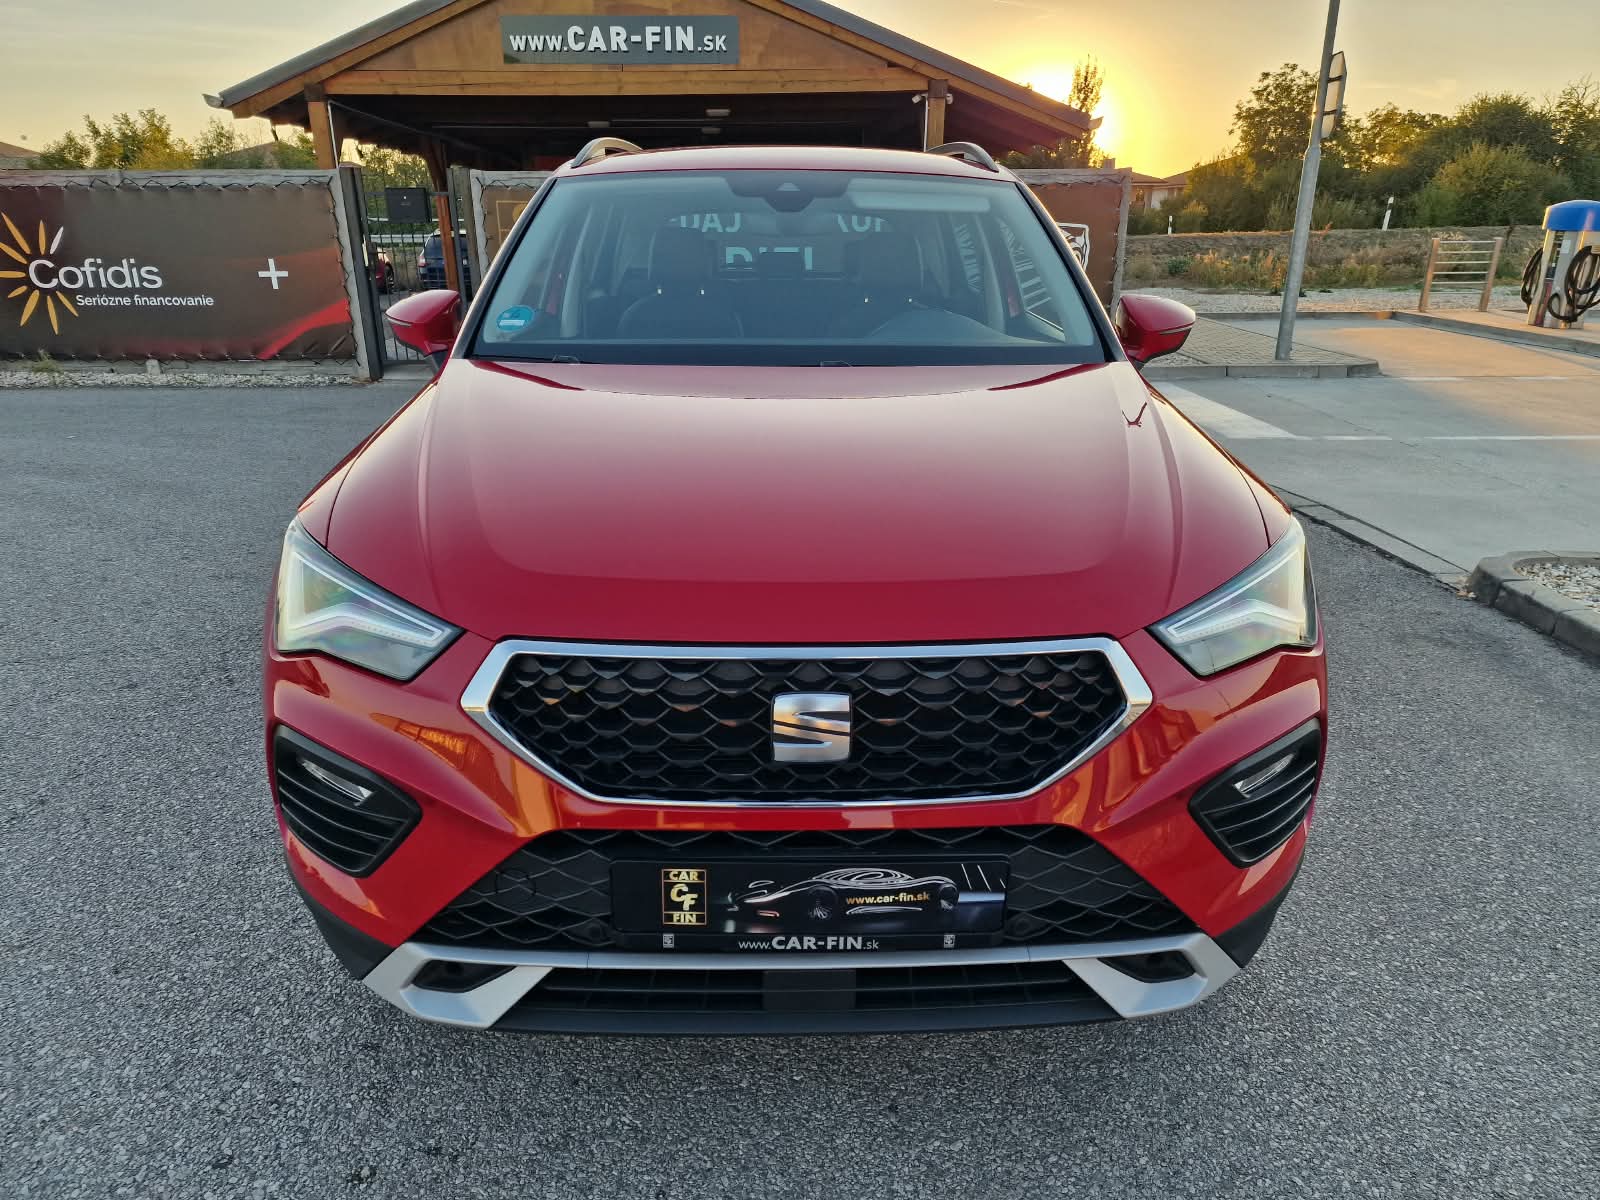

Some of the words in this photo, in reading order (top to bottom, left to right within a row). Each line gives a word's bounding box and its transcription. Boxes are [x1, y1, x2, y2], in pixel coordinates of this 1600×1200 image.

[28, 258, 163, 289] Cofidis
[76, 294, 131, 306] Seriózne
[134, 294, 214, 306] financovanie
[669, 871, 698, 881] CAR
[846, 892, 930, 905] www.car-fin.sk
[672, 913, 697, 923] FIN
[738, 936, 879, 950] www.CAR-FIN.sk
